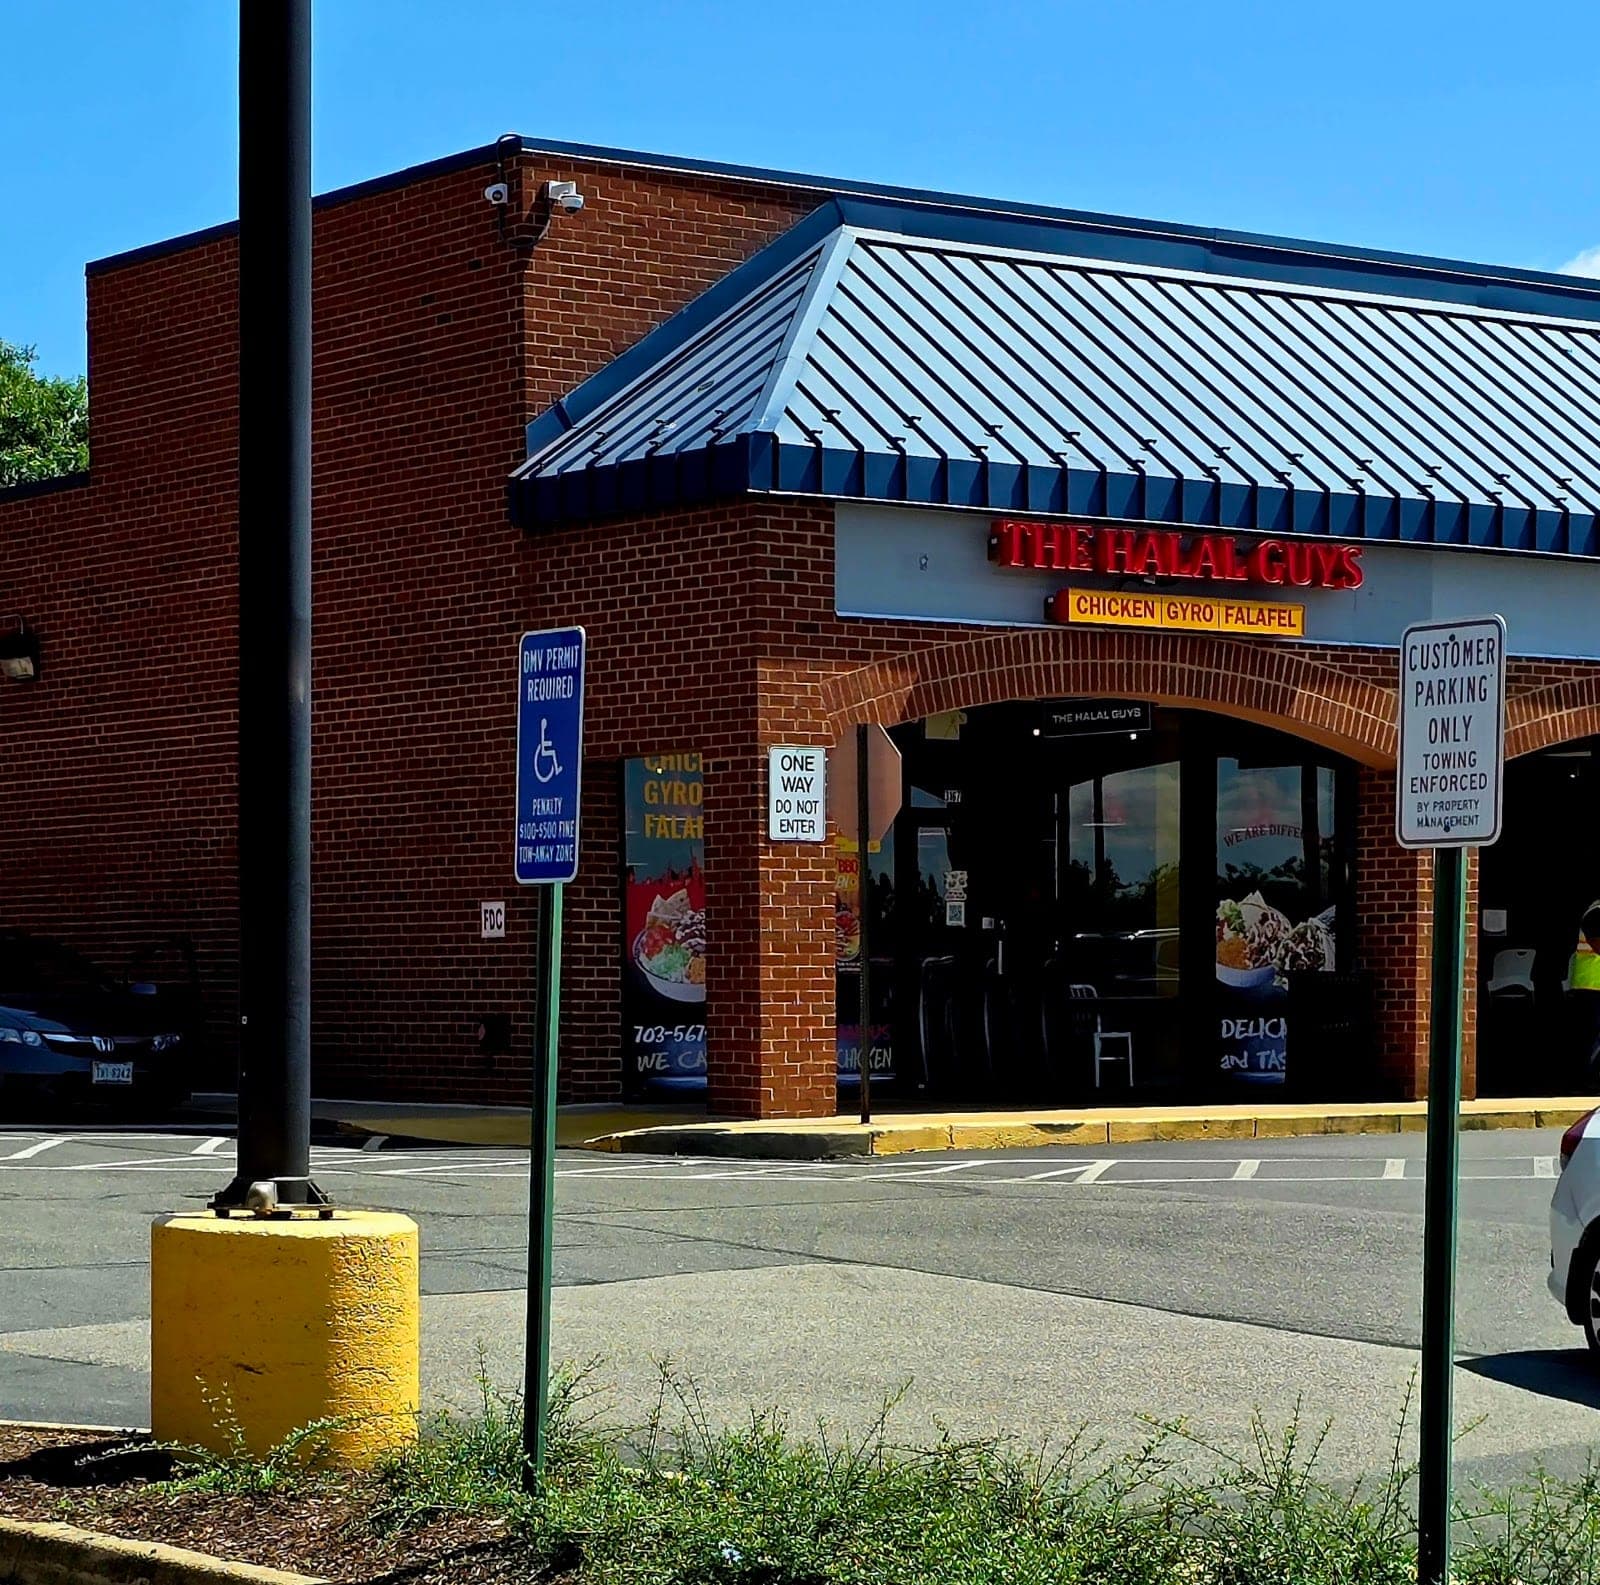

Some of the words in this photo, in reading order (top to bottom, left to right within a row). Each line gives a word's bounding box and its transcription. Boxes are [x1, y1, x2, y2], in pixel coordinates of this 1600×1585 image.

[1000, 520, 1094, 571] THE
[1104, 528, 1248, 580] HALAL
[1253, 539, 1364, 590] GUYS
[1076, 595, 1155, 619] CHICKEN
[1167, 601, 1214, 623] GYRO
[1225, 605, 1297, 628] FALAFEL
[523, 649, 544, 673] DMV
[546, 645, 580, 671] PERMIT
[1409, 638, 1495, 672] CUSTOMER
[527, 675, 574, 702] REQUIRED
[1415, 675, 1488, 707] PARKING
[1052, 713, 1073, 724] THE
[1075, 710, 1110, 721] HALAL
[1111, 707, 1141, 719] GUYS
[1428, 715, 1473, 744] ONLY
[780, 754, 816, 772] ONE
[1423, 751, 1477, 770] TOWING
[643, 780, 703, 807] GYRO
[781, 776, 814, 793] WAY
[1410, 773, 1488, 794] ENFORCED
[532, 797, 563, 817] PENALTY
[775, 799, 792, 814] DO
[796, 800, 820, 815] NOT
[1416, 800, 1430, 813] BY
[1432, 799, 1480, 812] PROPERTY
[558, 820, 575, 838] FINE
[779, 819, 816, 834] ENTER
[1416, 814, 1480, 829] MANAGEMENT
[1224, 830, 1243, 847] WE
[1245, 824, 1267, 840] ARE
[519, 845, 554, 864] TOW-AWAY
[555, 844, 574, 862] ZONE
[484, 908, 503, 931] FDC
[637, 1052, 671, 1073] WE
[1219, 1049, 1249, 1070] and
